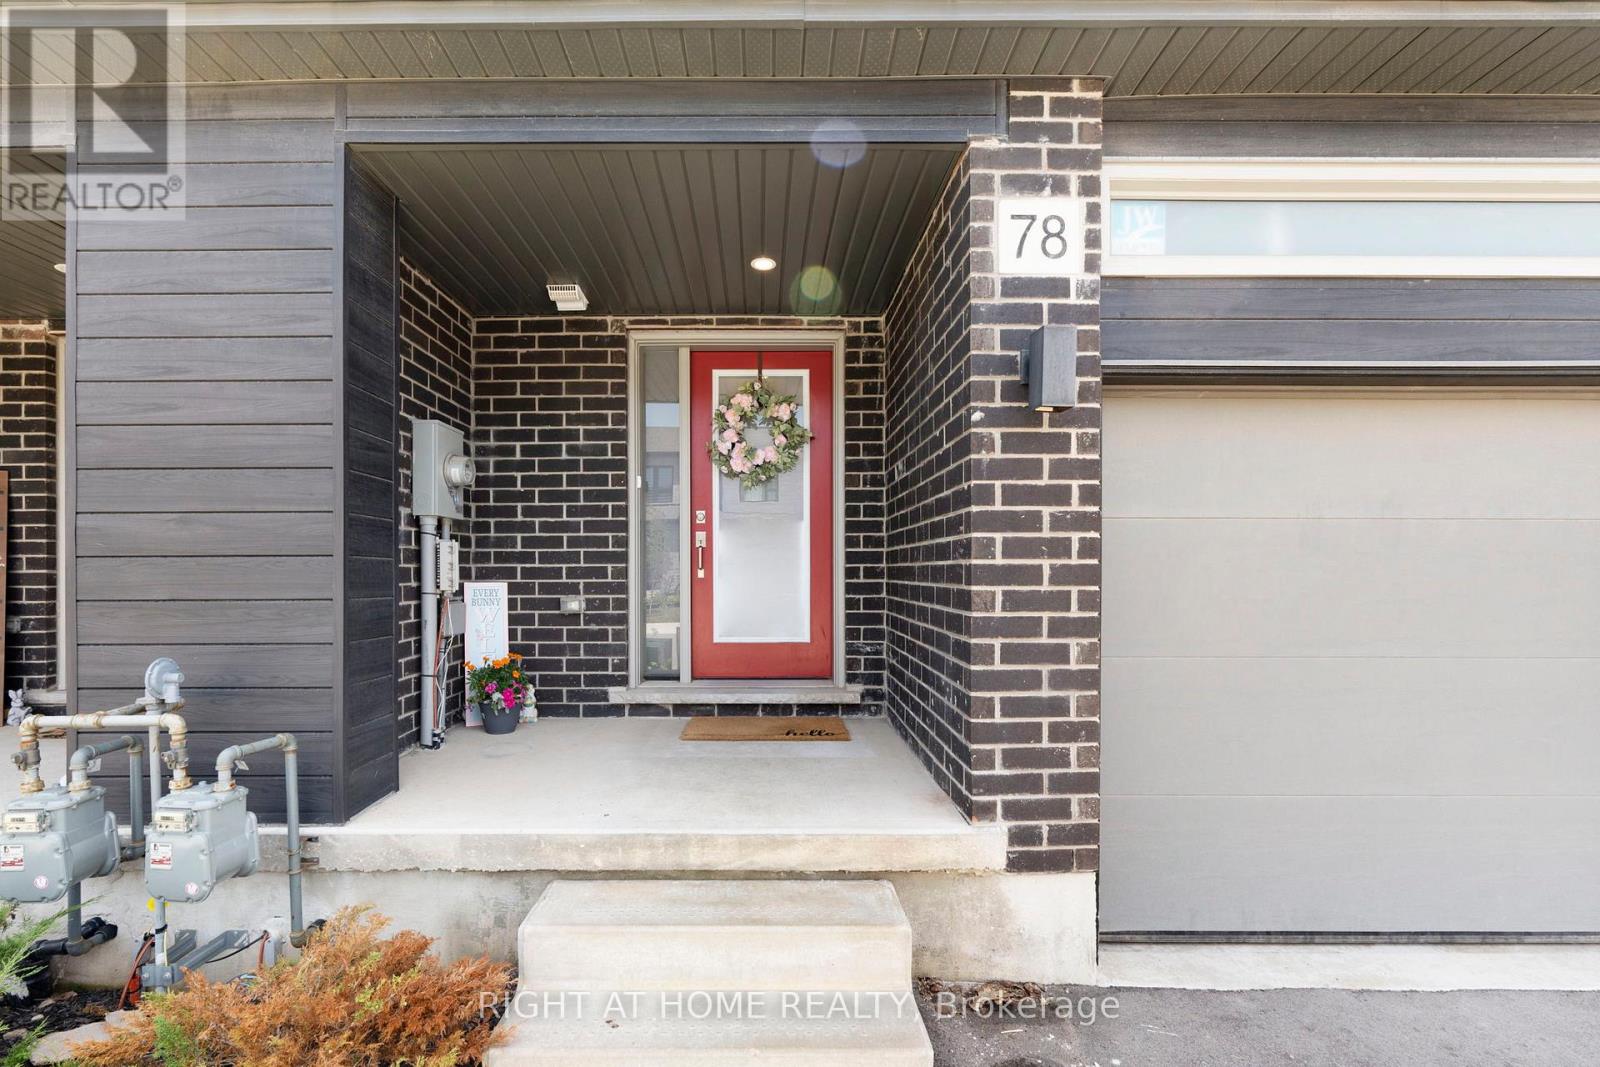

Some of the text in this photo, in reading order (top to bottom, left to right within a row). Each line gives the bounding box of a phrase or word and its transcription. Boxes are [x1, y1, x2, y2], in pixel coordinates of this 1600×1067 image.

[1010, 214, 1068, 260] 78
[473, 588, 500, 597] EVERY
[471, 598, 501, 607] BUNNY
[784, 729, 836, 737] hello
